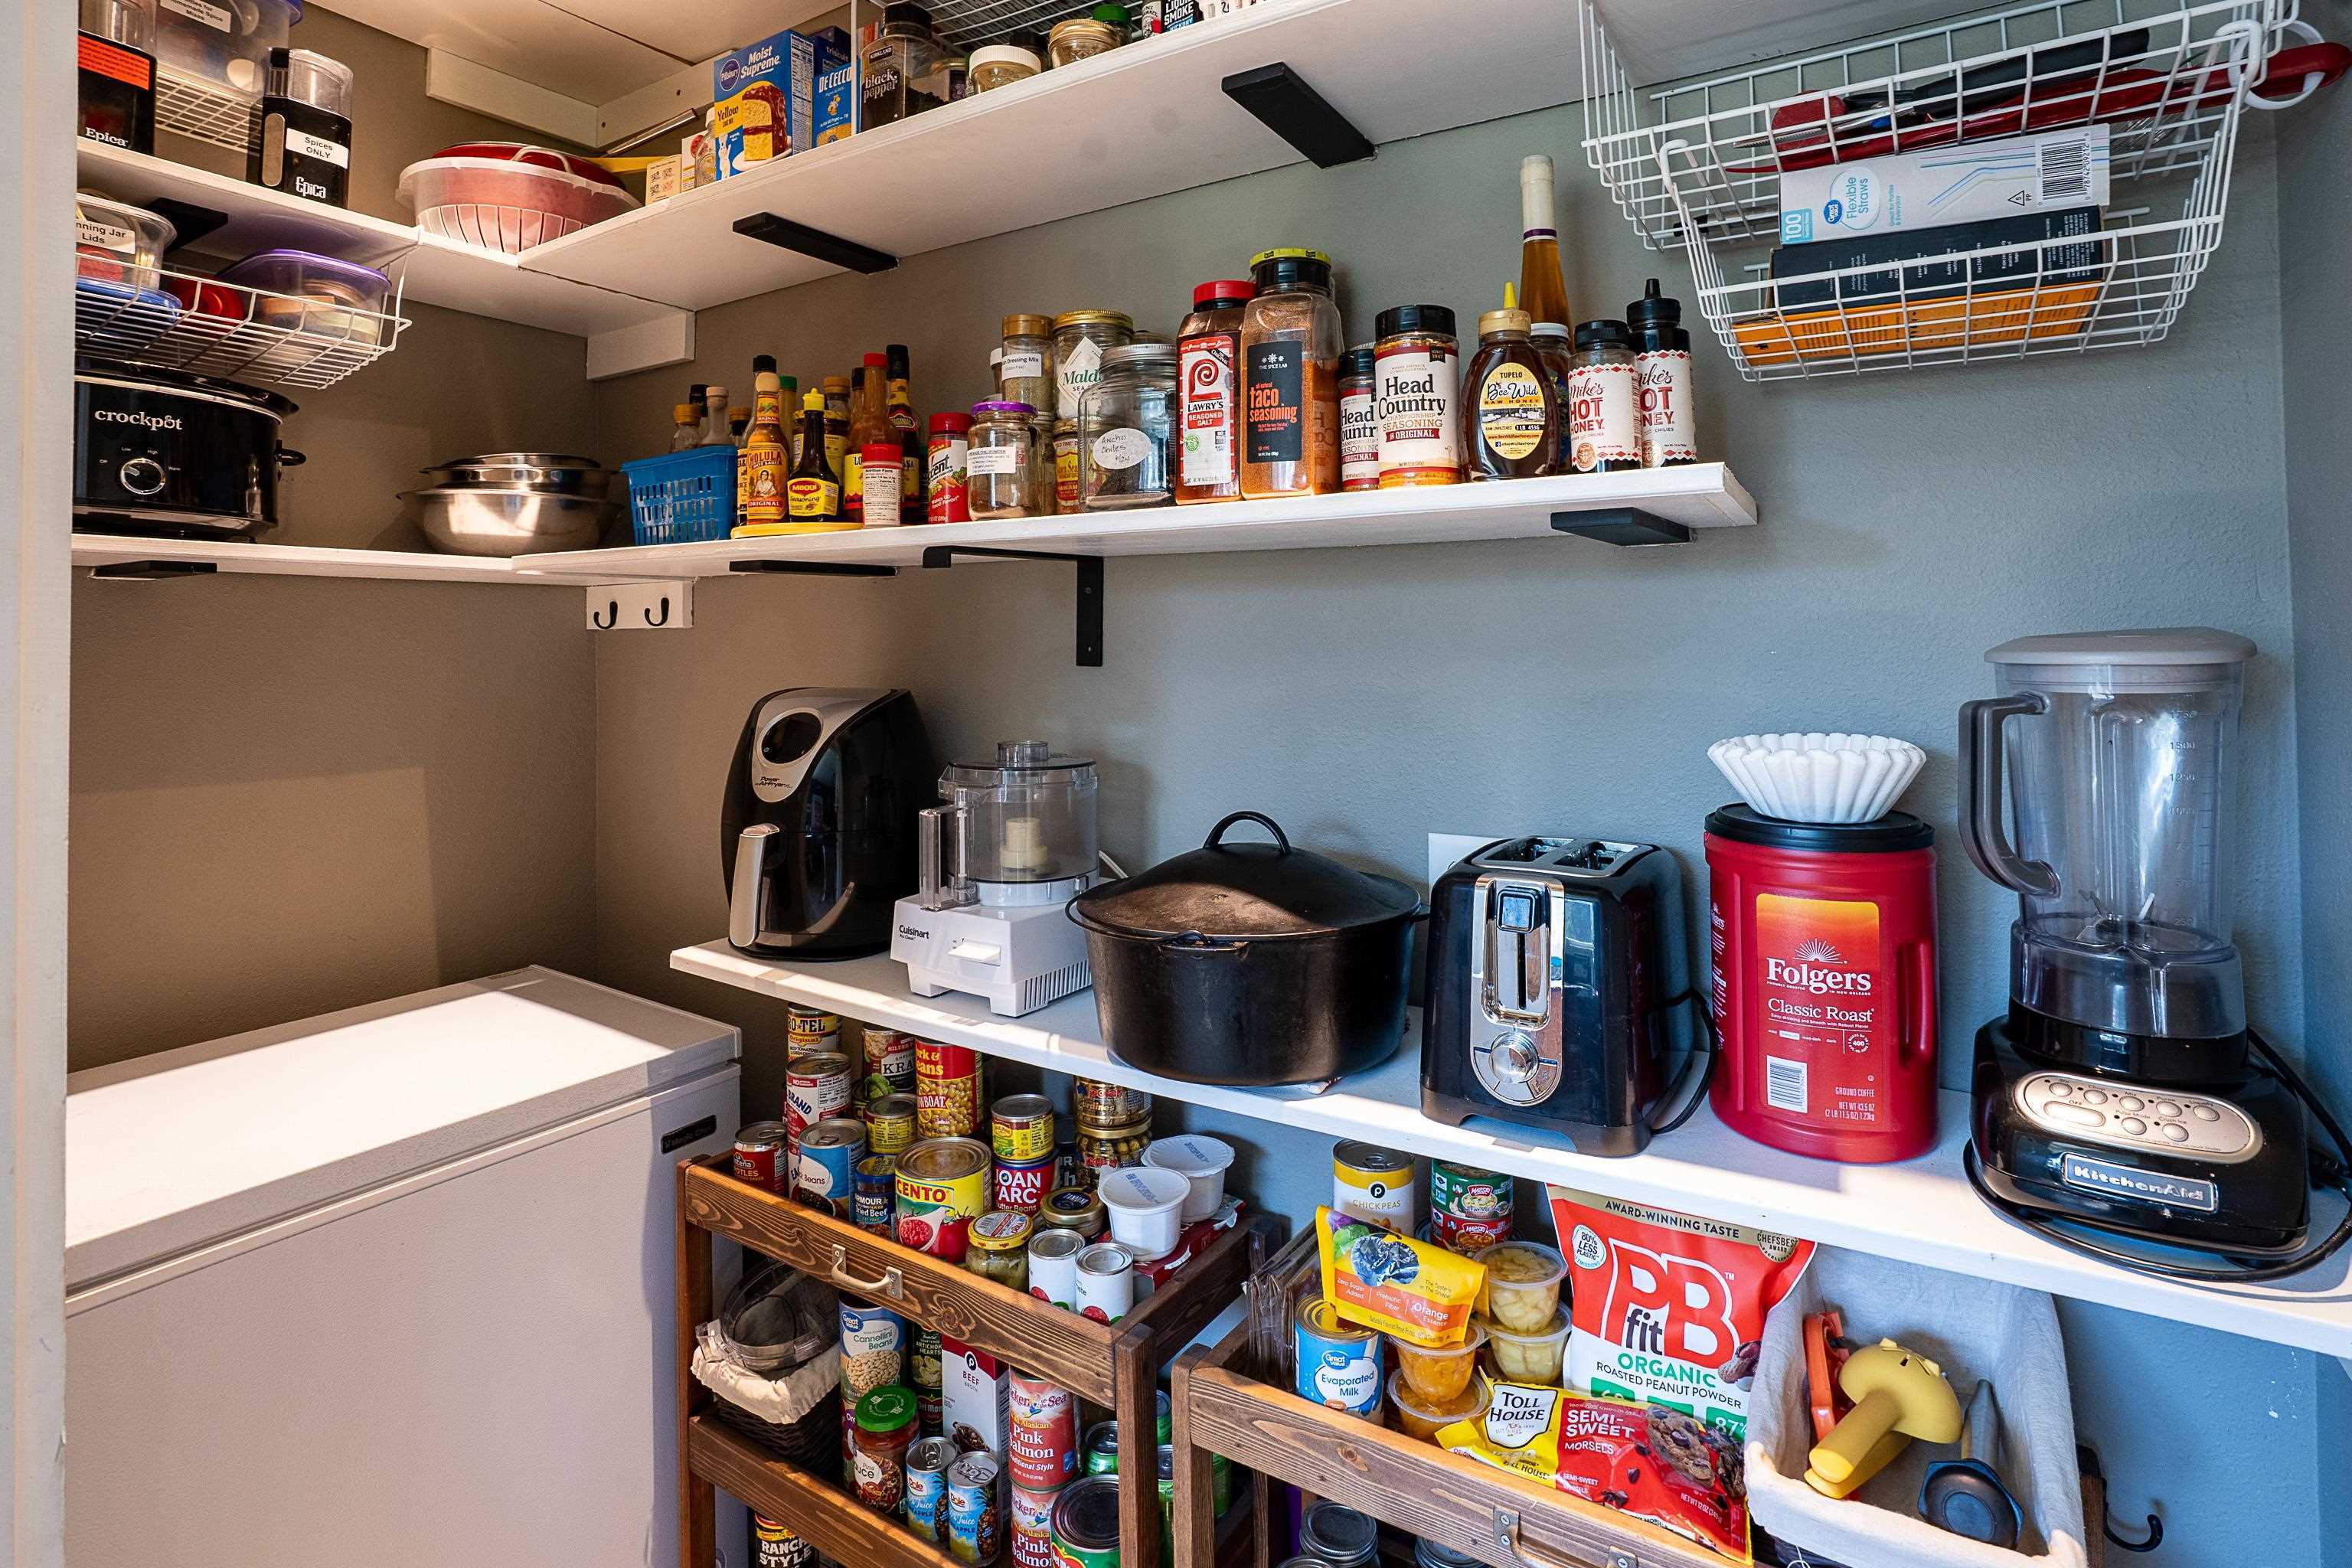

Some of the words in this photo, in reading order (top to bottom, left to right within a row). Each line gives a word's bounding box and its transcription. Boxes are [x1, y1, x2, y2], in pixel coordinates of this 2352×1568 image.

[1164, 2, 1194, 24] SMOKE
[748, 45, 773, 65] Moist
[870, 47, 892, 60] KIRKLAND
[740, 55, 780, 78] Supreme
[865, 69, 894, 89] black
[864, 80, 896, 103] pepper
[717, 104, 739, 122] Yellow
[85, 126, 127, 147] Epica
[304, 136, 334, 151] Spices
[305, 145, 332, 159] ONLY
[296, 177, 326, 199] Epica
[1846, 177, 1857, 219] Flexible
[1858, 178, 1869, 214] Straws
[109, 226, 126, 238] Jar
[1785, 213, 1802, 241] 100
[82, 233, 105, 244] Lids
[1385, 374, 1435, 397] Head
[1488, 382, 1508, 400] Bee
[1508, 382, 1539, 399] Wild
[1570, 377, 1604, 401] Mike's
[1250, 387, 1279, 408] taco
[1640, 386, 1673, 412] OT
[1187, 401, 1223, 412] LAWRY'S
[1250, 403, 1298, 423] seasoning
[1378, 394, 1446, 420] Country
[1570, 397, 1603, 423] HOT
[94, 410, 183, 431] crockpot
[1188, 411, 1223, 421] SEASONED
[1341, 405, 1375, 426] Head
[1387, 413, 1436, 422] CHAMPIONSHIP
[1383, 419, 1443, 431] SEASONING
[1102, 433, 1127, 443] Ancho
[1395, 430, 1435, 439] ORIGINAL
[1101, 444, 1126, 453] Chiles
[749, 450, 782, 469] CHOLULA
[899, 925, 929, 939] Cuisinart
[1766, 956, 1872, 995] Folgers
[1768, 998, 1821, 1018] Classic
[1825, 1006, 1873, 1023] Roast
[789, 1035, 819, 1044] Original
[931, 1052, 940, 1061] &
[1835, 1086, 1857, 1096] GROUND
[1857, 1089, 1875, 1097] COFFEE
[788, 1089, 812, 1115] BRAND
[1839, 1101, 1848, 1109] NET
[1849, 1102, 1857, 1110] WT
[1857, 1102, 1868, 1112] 43.5
[1868, 1103, 1875, 1112] OZ
[1824, 1108, 1831, 1118] (2
[1839, 1109, 1850, 1119] 11.5
[1850, 1111, 1859, 1120] OZ)
[804, 1174, 826, 1184] Beans
[995, 1169, 1041, 1188] JOAN
[2073, 1163, 2205, 1203] KitchenAid
[897, 1179, 946, 1202] CENTO
[1014, 1204, 1037, 1213] Beans
[1353, 1198, 1401, 1210] CHICKPEAS
[870, 1208, 887, 1217] Beef
[1605, 1200, 1700, 1231] AWARD-WINNING
[1704, 1223, 1740, 1240] TASTE
[1581, 1231, 1598, 1246] 80%
[1576, 1249, 1596, 1260] PLASTIC
[1578, 1240, 1598, 1255] LESS
[1769, 1244, 1788, 1253] AWARD
[1337, 1277, 1348, 1287] Zero
[1349, 1281, 1365, 1292] Sugar
[1346, 1289, 1364, 1299] Added
[1376, 1292, 1402, 1304] Prebiotic
[1384, 1302, 1400, 1312] Fiber
[1599, 1236, 1740, 1370] PB
[1414, 1302, 1449, 1321] Orange
[843, 1315, 858, 1325] Great
[854, 1331, 893, 1343] Cannellini
[1625, 1308, 1663, 1356] fit
[868, 1340, 893, 1350] Beans
[1325, 1354, 1345, 1364] Great
[962, 1370, 980, 1385] BEEF
[1618, 1352, 1717, 1388] ORGANIC
[1321, 1370, 1374, 1387] Evaporated
[1596, 1361, 1643, 1387] ROASTED
[1645, 1376, 1689, 1396] PEANUT
[1692, 1387, 1741, 1410] POWDER
[964, 1381, 978, 1393] BROTH
[1340, 1387, 1359, 1396] Milk
[1047, 1394, 1067, 1407] Sea
[1501, 1391, 1540, 1408] TOLL
[1489, 1406, 1545, 1422] HOUSE
[1567, 1410, 1624, 1424] SEMI-
[1021, 1420, 1050, 1429] Alaskan
[1566, 1423, 1635, 1439] SWEET
[1013, 1422, 1044, 1444] Pink
[1564, 1440, 1614, 1455] MORSELS
[1036, 1463, 1054, 1472] Style
[909, 1477, 923, 1491] Dole
[1563, 1472, 1599, 1486] SEMI-SWEET
[916, 1500, 933, 1508] Juice
[950, 1493, 965, 1508] Dole
[1681, 1492, 1690, 1503] NET
[957, 1514, 975, 1525] Juice
[1017, 1533, 1049, 1553] Pink
[759, 1546, 812, 1568] STYLE
